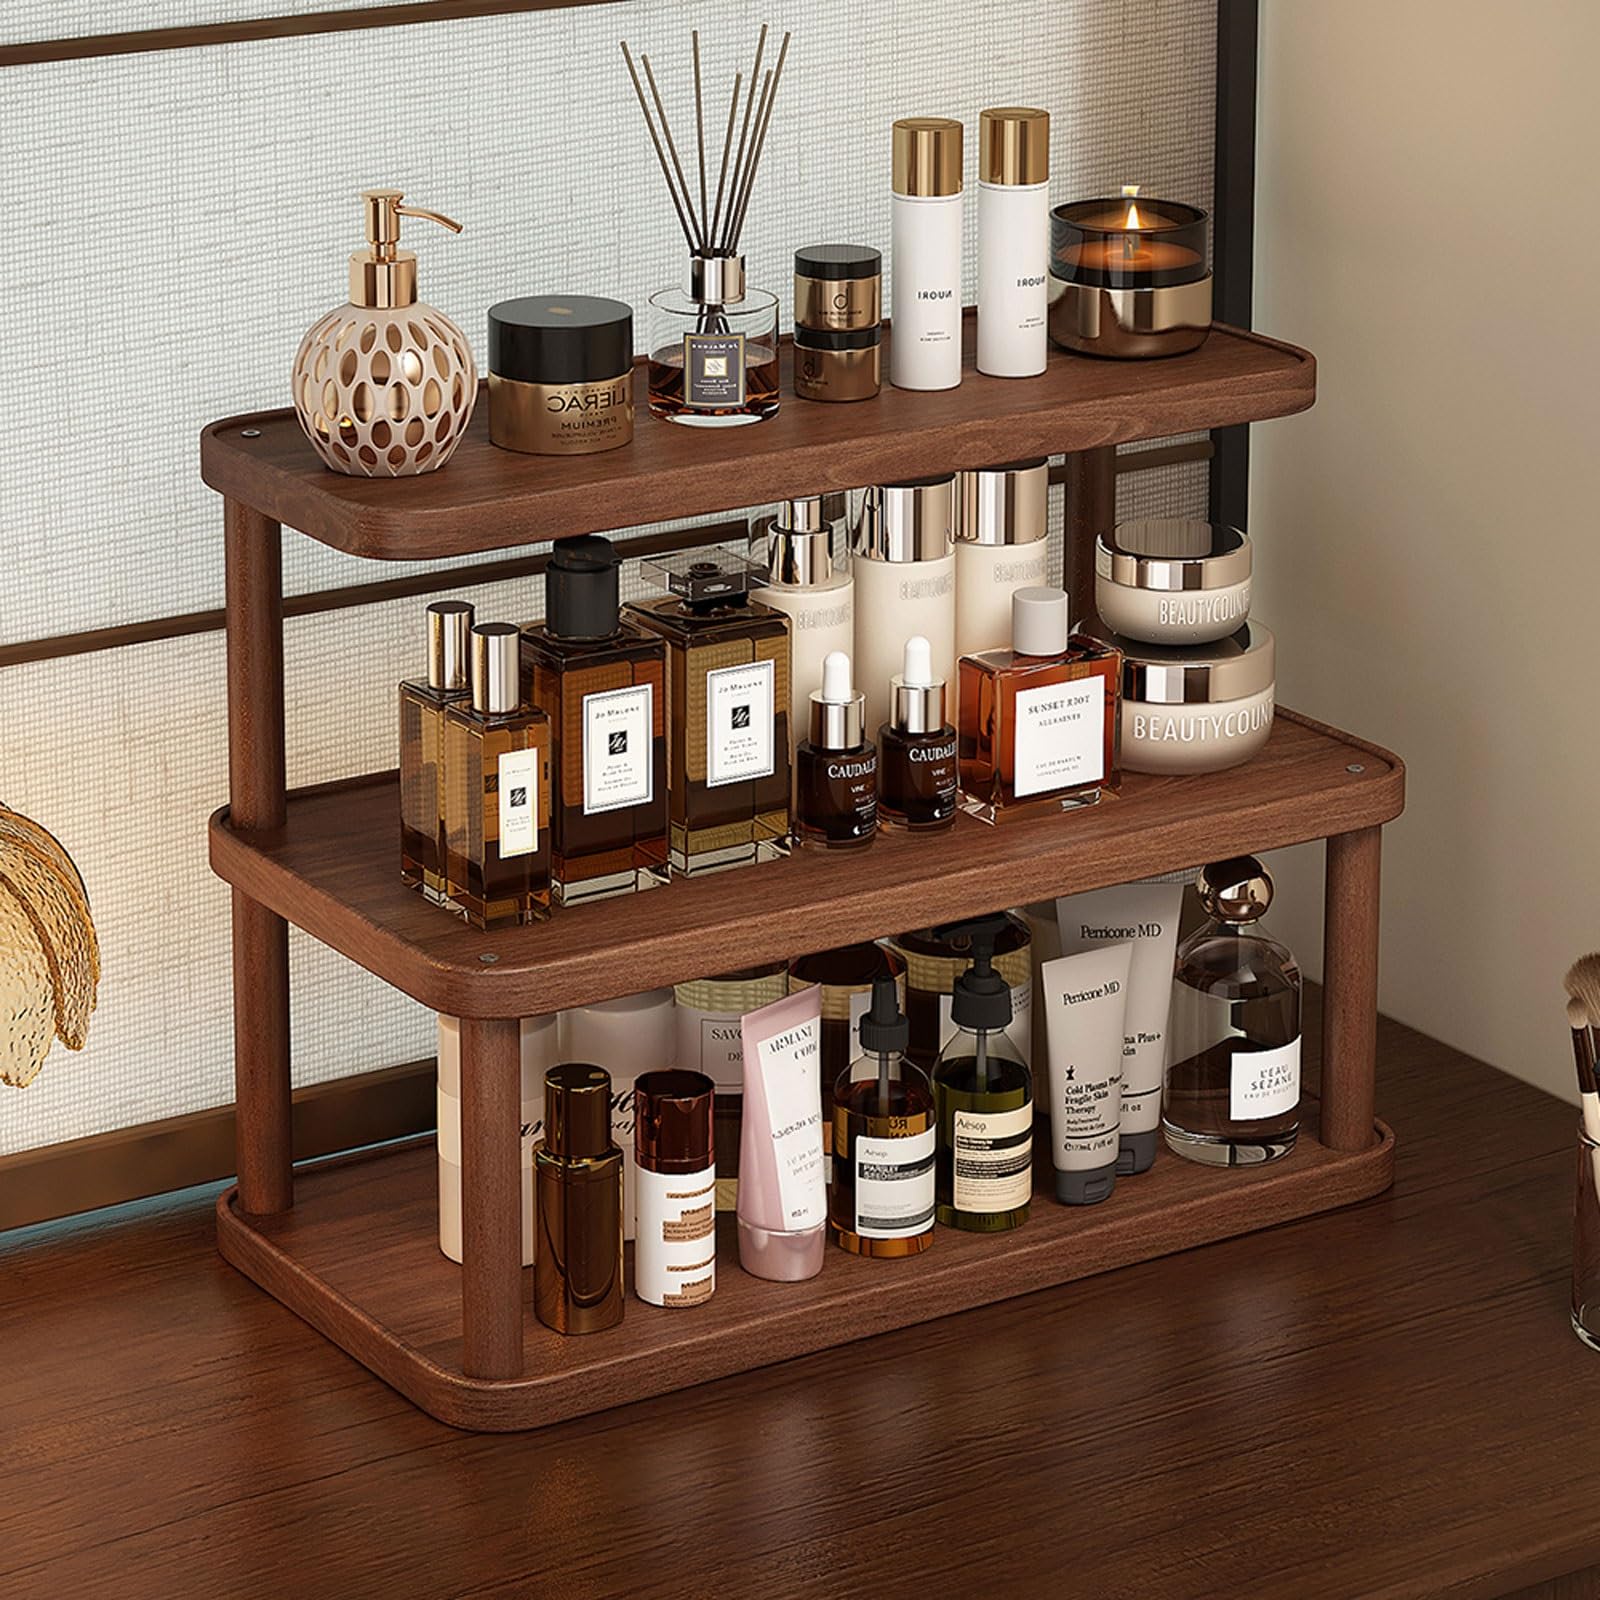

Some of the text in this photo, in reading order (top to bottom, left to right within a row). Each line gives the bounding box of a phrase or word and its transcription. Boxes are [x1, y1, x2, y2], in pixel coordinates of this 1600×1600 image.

[1028, 700, 1065, 715] SUNSET
[1080, 923, 1162, 939] Perricone MD
[1062, 980, 1121, 1006] Perricone MD
